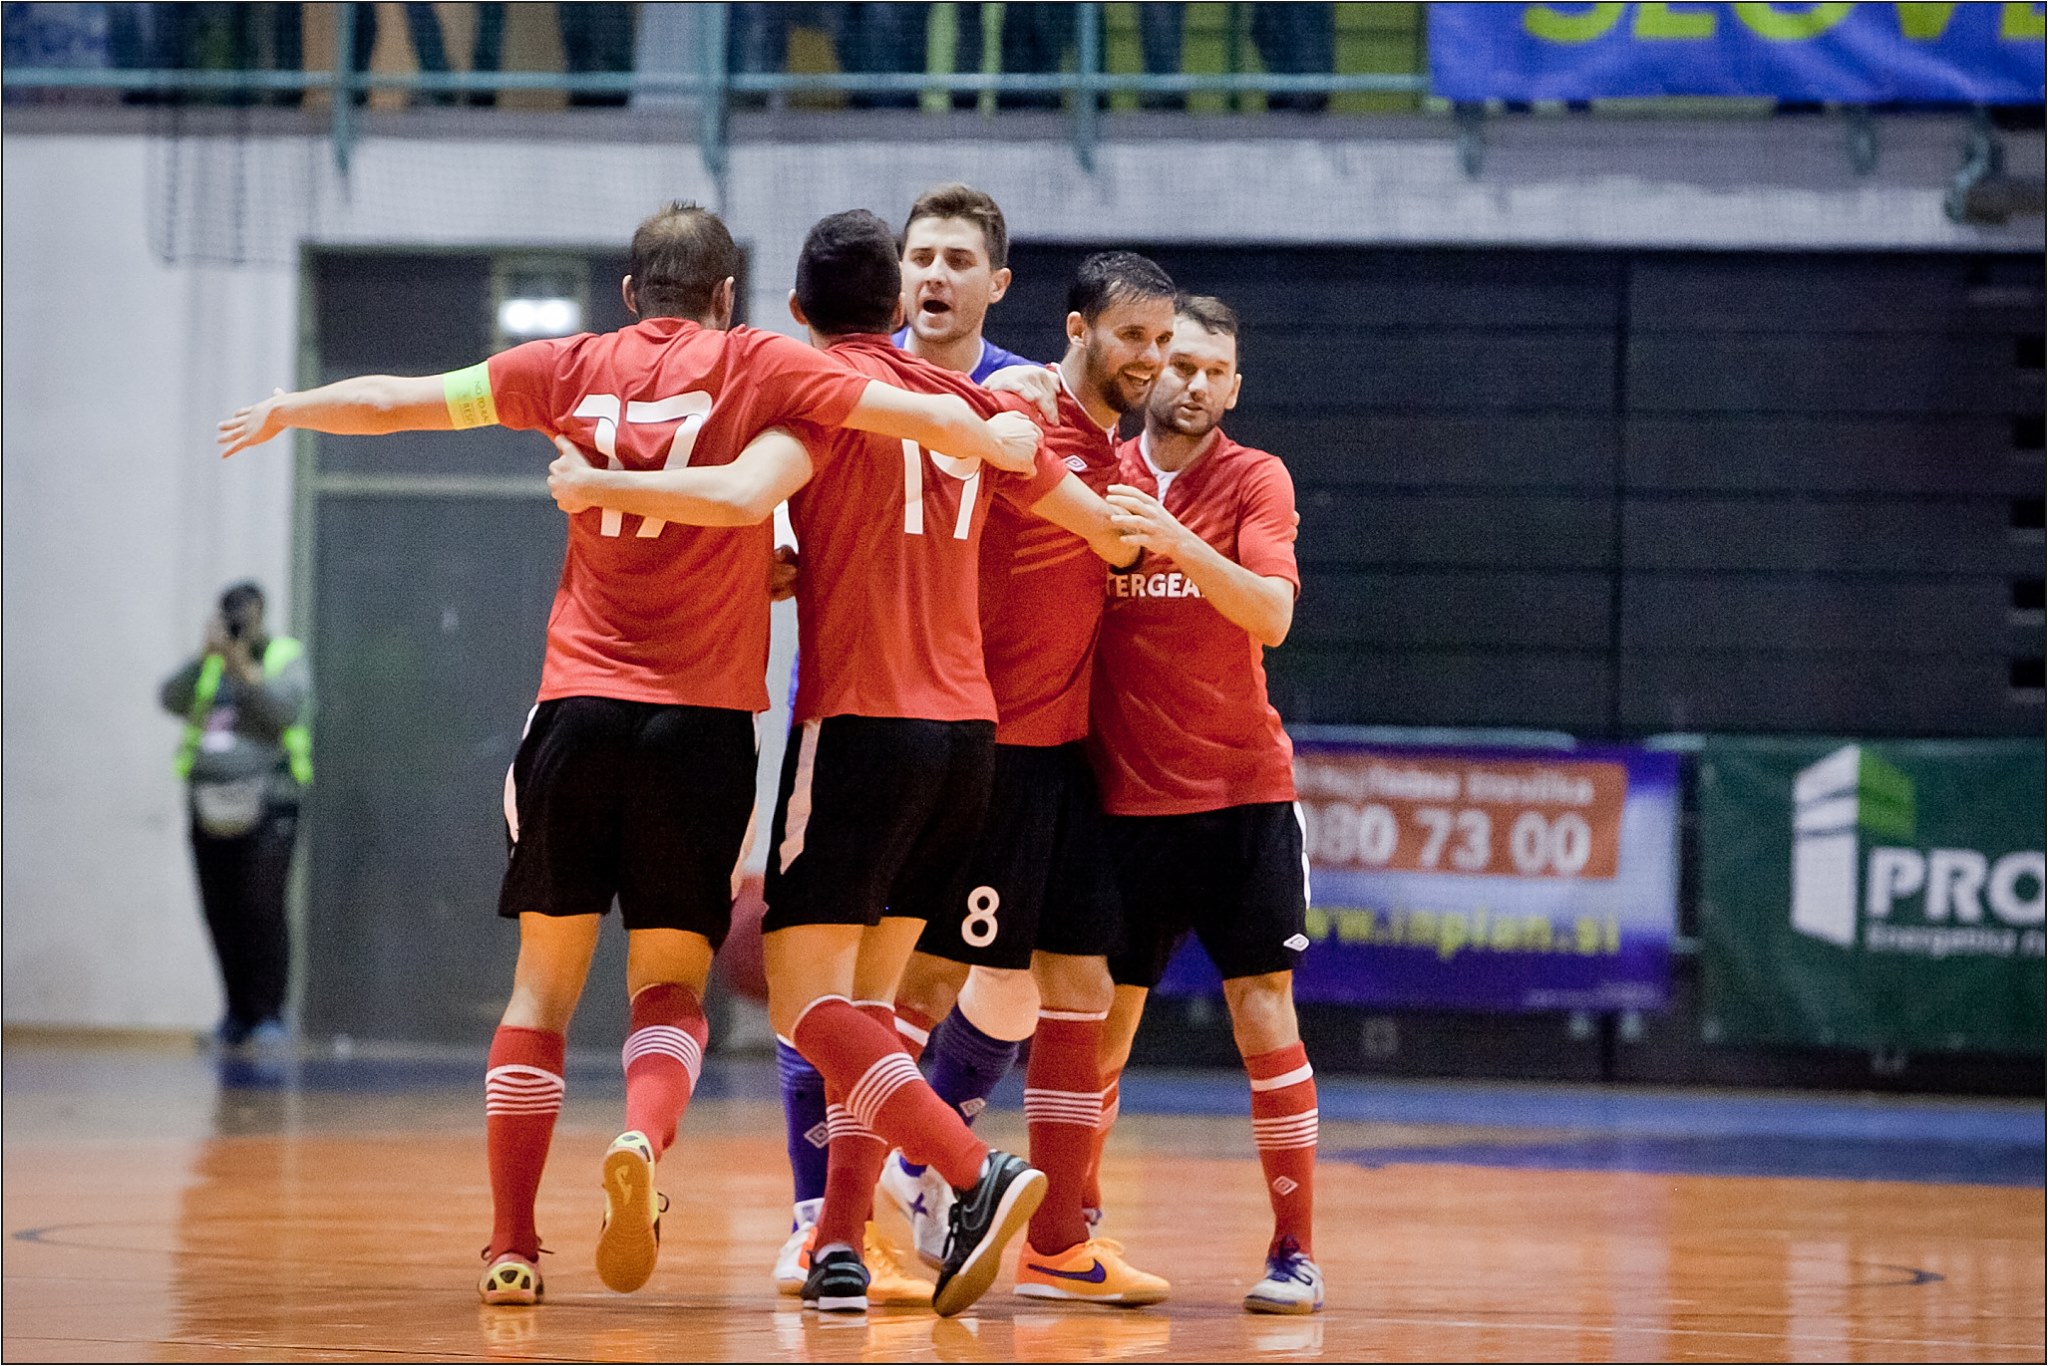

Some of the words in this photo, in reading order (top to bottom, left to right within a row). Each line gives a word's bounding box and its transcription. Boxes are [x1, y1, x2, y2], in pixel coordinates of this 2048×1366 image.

[572, 390, 713, 538] 17
[1414, 807, 1492, 872] 73
[1510, 810, 1592, 876] 00
[961, 885, 1000, 948] 8
